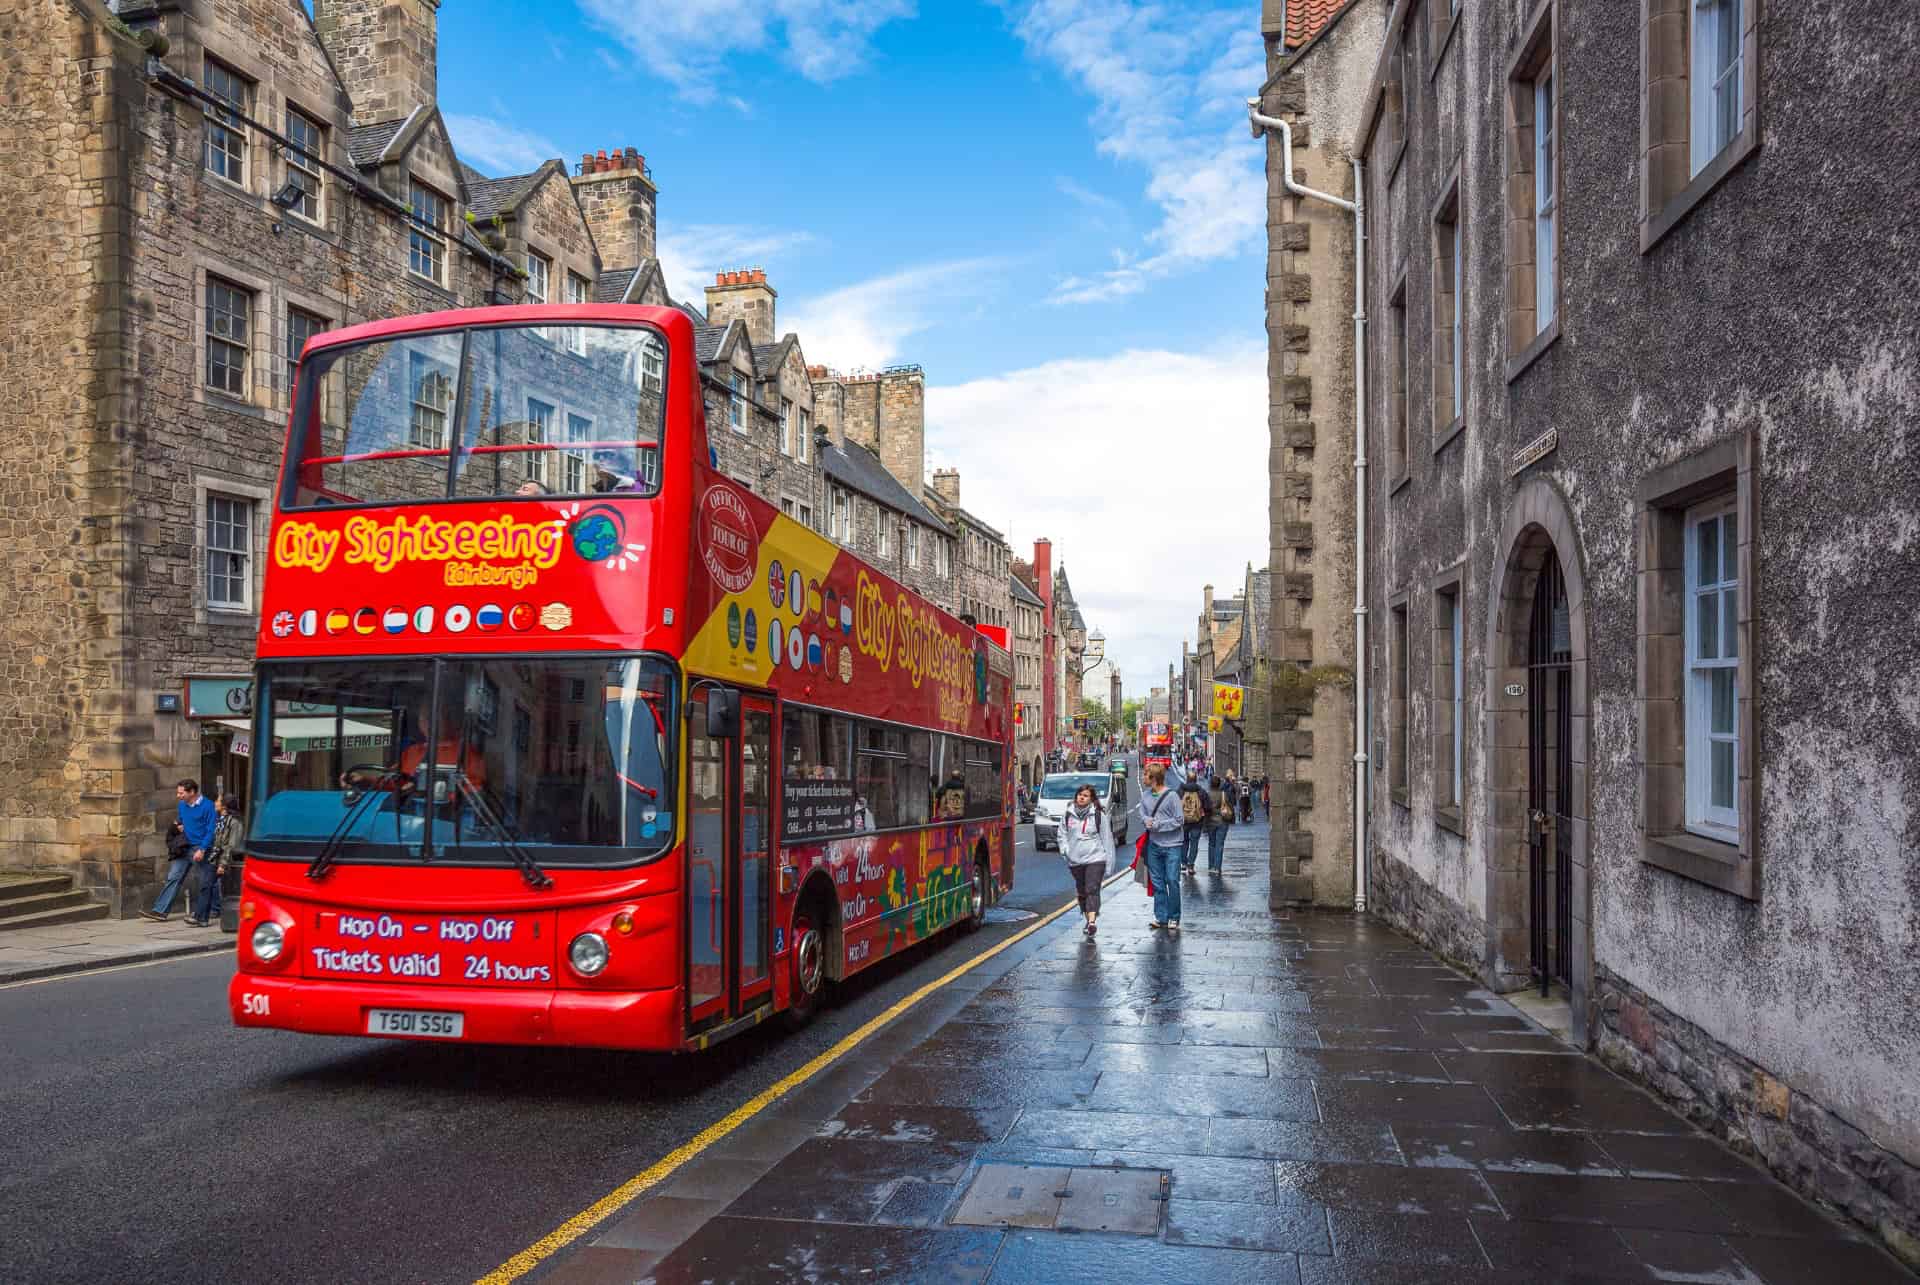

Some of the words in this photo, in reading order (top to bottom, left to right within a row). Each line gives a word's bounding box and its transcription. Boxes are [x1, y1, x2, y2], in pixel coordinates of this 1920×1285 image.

[710, 490, 747, 526] OFFICIAL
[275, 520, 339, 571] City
[345, 515, 562, 572] Sightseeing
[712, 524, 736, 550] TOUR
[737, 538, 749, 556] OF
[444, 562, 537, 589] Edinburgh
[705, 548, 753, 591] EDINBURGH
[856, 569, 894, 672] City
[897, 592, 974, 705] Sightseeing
[308, 736, 327, 749] ICE
[330, 735, 372, 748] CEAM
[855, 847, 868, 883] 24
[867, 864, 885, 881] hours
[842, 900, 856, 921] Hop
[856, 892, 866, 917] On
[339, 916, 375, 940] Hop
[377, 917, 403, 938] On
[441, 919, 476, 942] Hop
[482, 918, 514, 941] Off
[313, 947, 382, 974] Tickets
[389, 952, 440, 978] valid
[464, 955, 490, 980] 24
[495, 962, 551, 982] hours
[242, 993, 270, 1017] 501
[378, 1012, 416, 1032] T501
[420, 1014, 454, 1034] SSG
